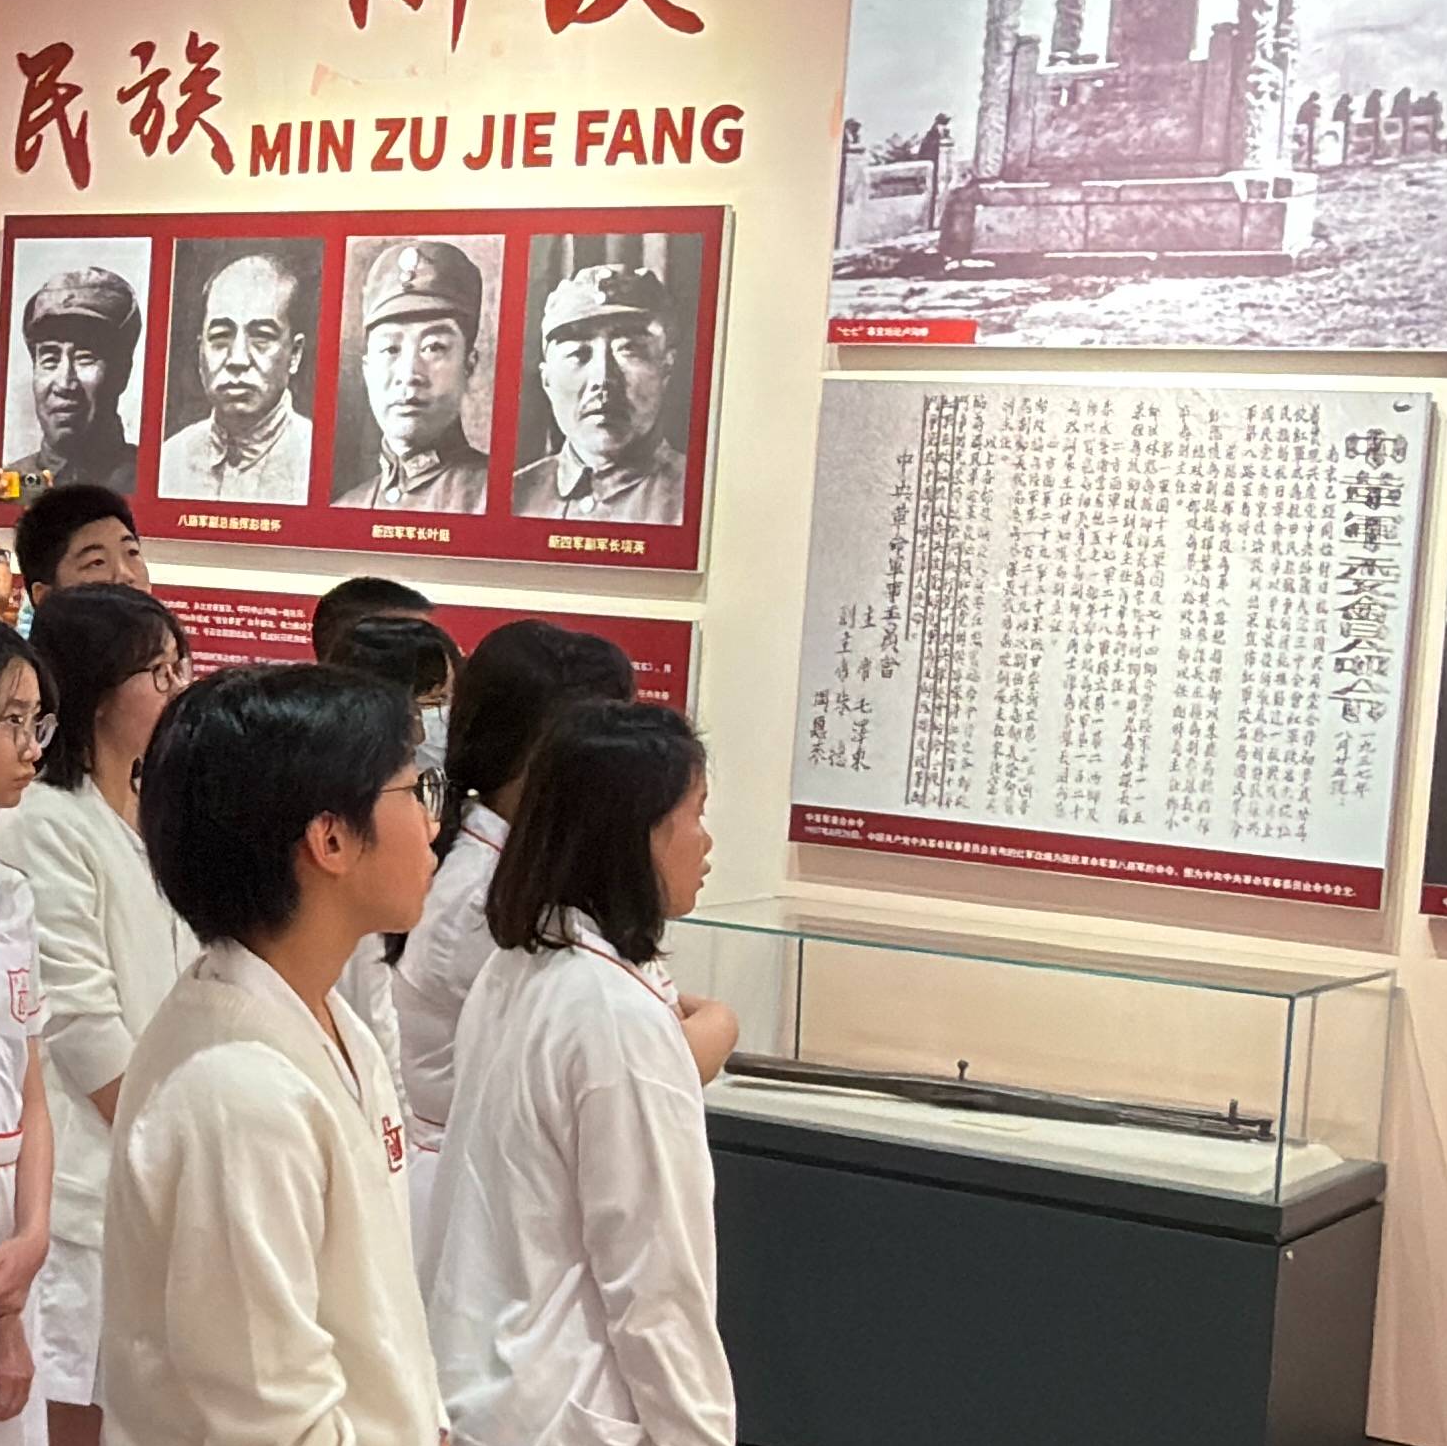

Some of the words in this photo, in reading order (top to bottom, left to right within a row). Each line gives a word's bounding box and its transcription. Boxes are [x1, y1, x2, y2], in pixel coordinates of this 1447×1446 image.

[14, 31, 234, 190] 民族
[250, 116, 355, 177] MIN
[371, 116, 447, 172] ZU
[463, 111, 555, 170] JIE
[574, 104, 744, 167] FANG
